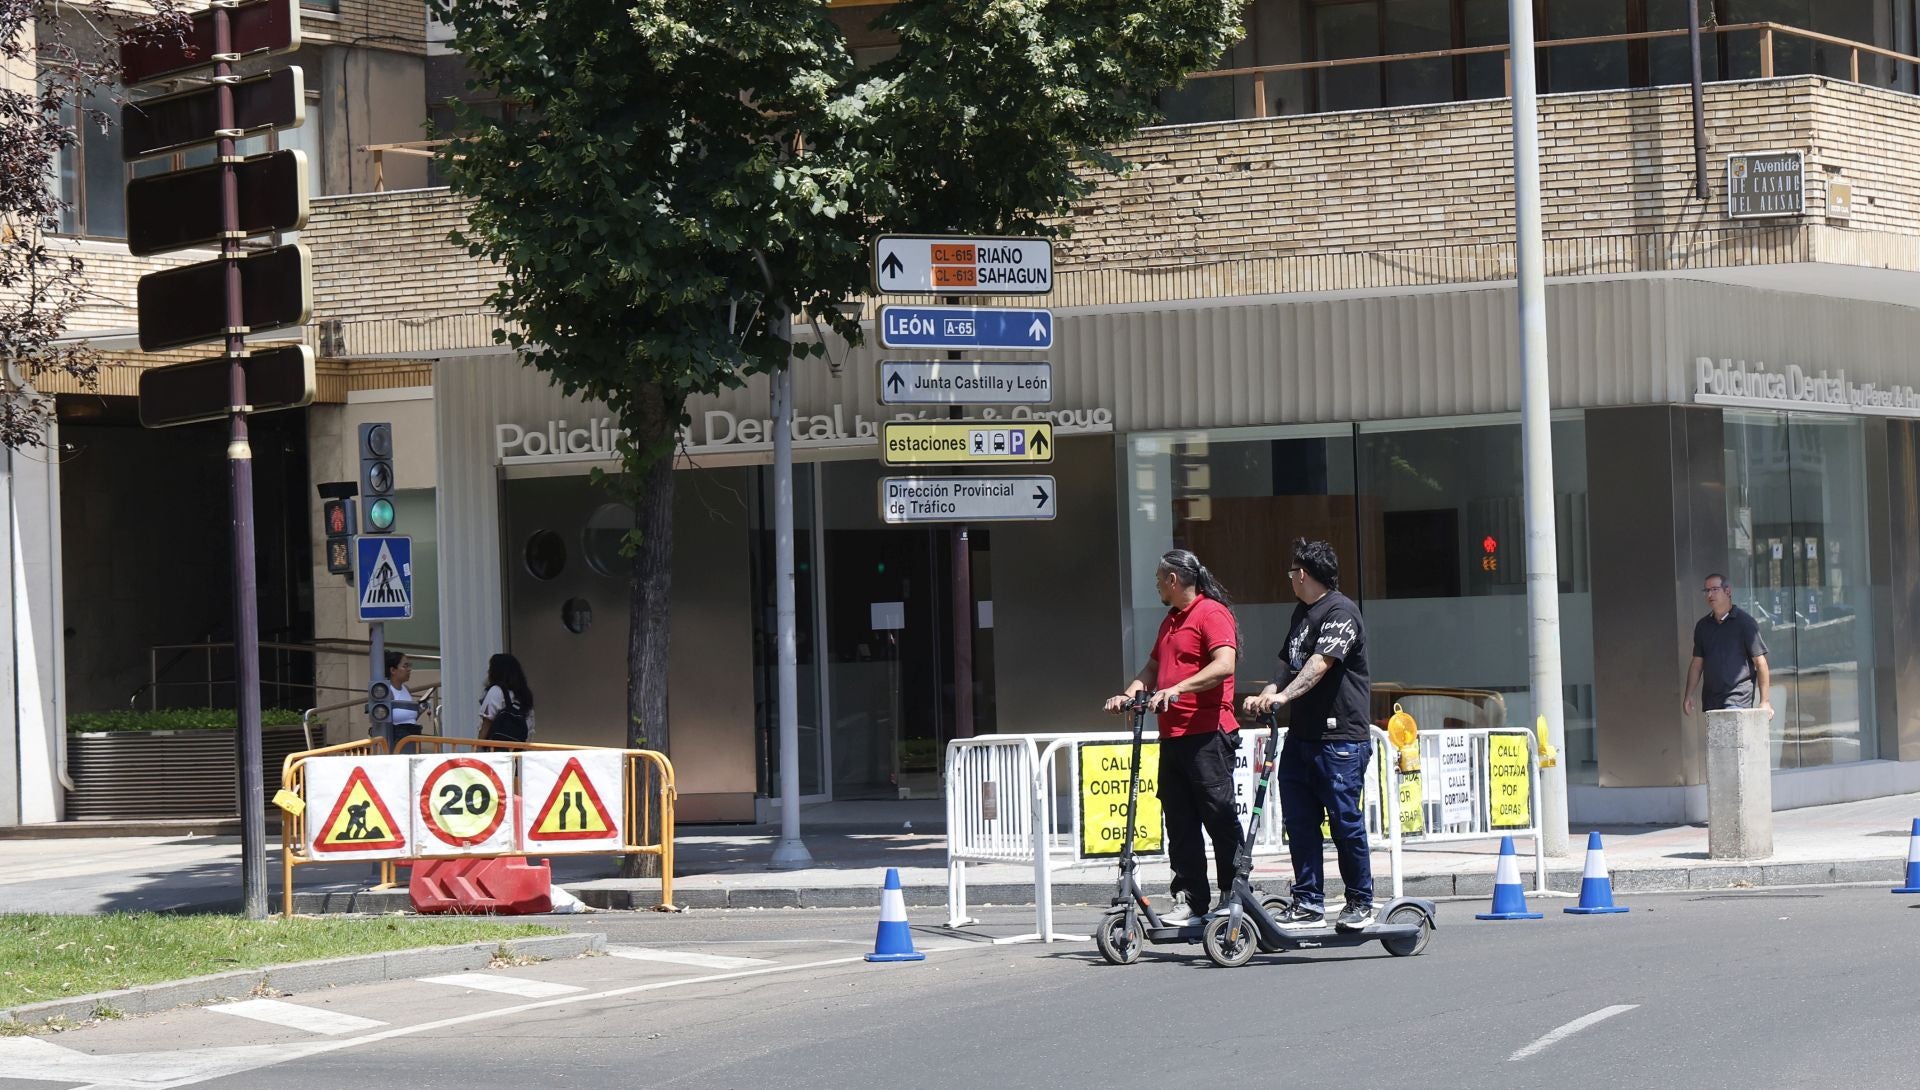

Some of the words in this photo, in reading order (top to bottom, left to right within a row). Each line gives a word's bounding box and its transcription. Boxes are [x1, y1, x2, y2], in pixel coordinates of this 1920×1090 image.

[1753, 159, 1799, 173] Avenida
[1732, 178, 1746, 194] DE
[1732, 196, 1751, 213] DEL
[978, 246, 1022, 264] RIAÑO
[978, 268, 1047, 284] SAHAGUN
[889, 314, 935, 336] LEÓN
[946, 322, 972, 335] A-65
[914, 375, 951, 390] Junta
[955, 375, 1003, 390] Castilla
[1006, 379, 1013, 392] y
[1017, 375, 1048, 390] León
[1786, 364, 1847, 404] Dental
[889, 436, 967, 451] estaciones
[889, 484, 949, 498] Dirección
[954, 483, 1014, 497] Provincial
[890, 501, 905, 514] de
[910, 500, 956, 513] Tráfico
[1447, 735, 1464, 748] CALLE
[1442, 752, 1467, 765] CORTADA
[1090, 778, 1155, 795] CORTDA
[1448, 775, 1466, 788] CALLE
[439, 783, 490, 816] 20
[1400, 790, 1411, 803] OR
